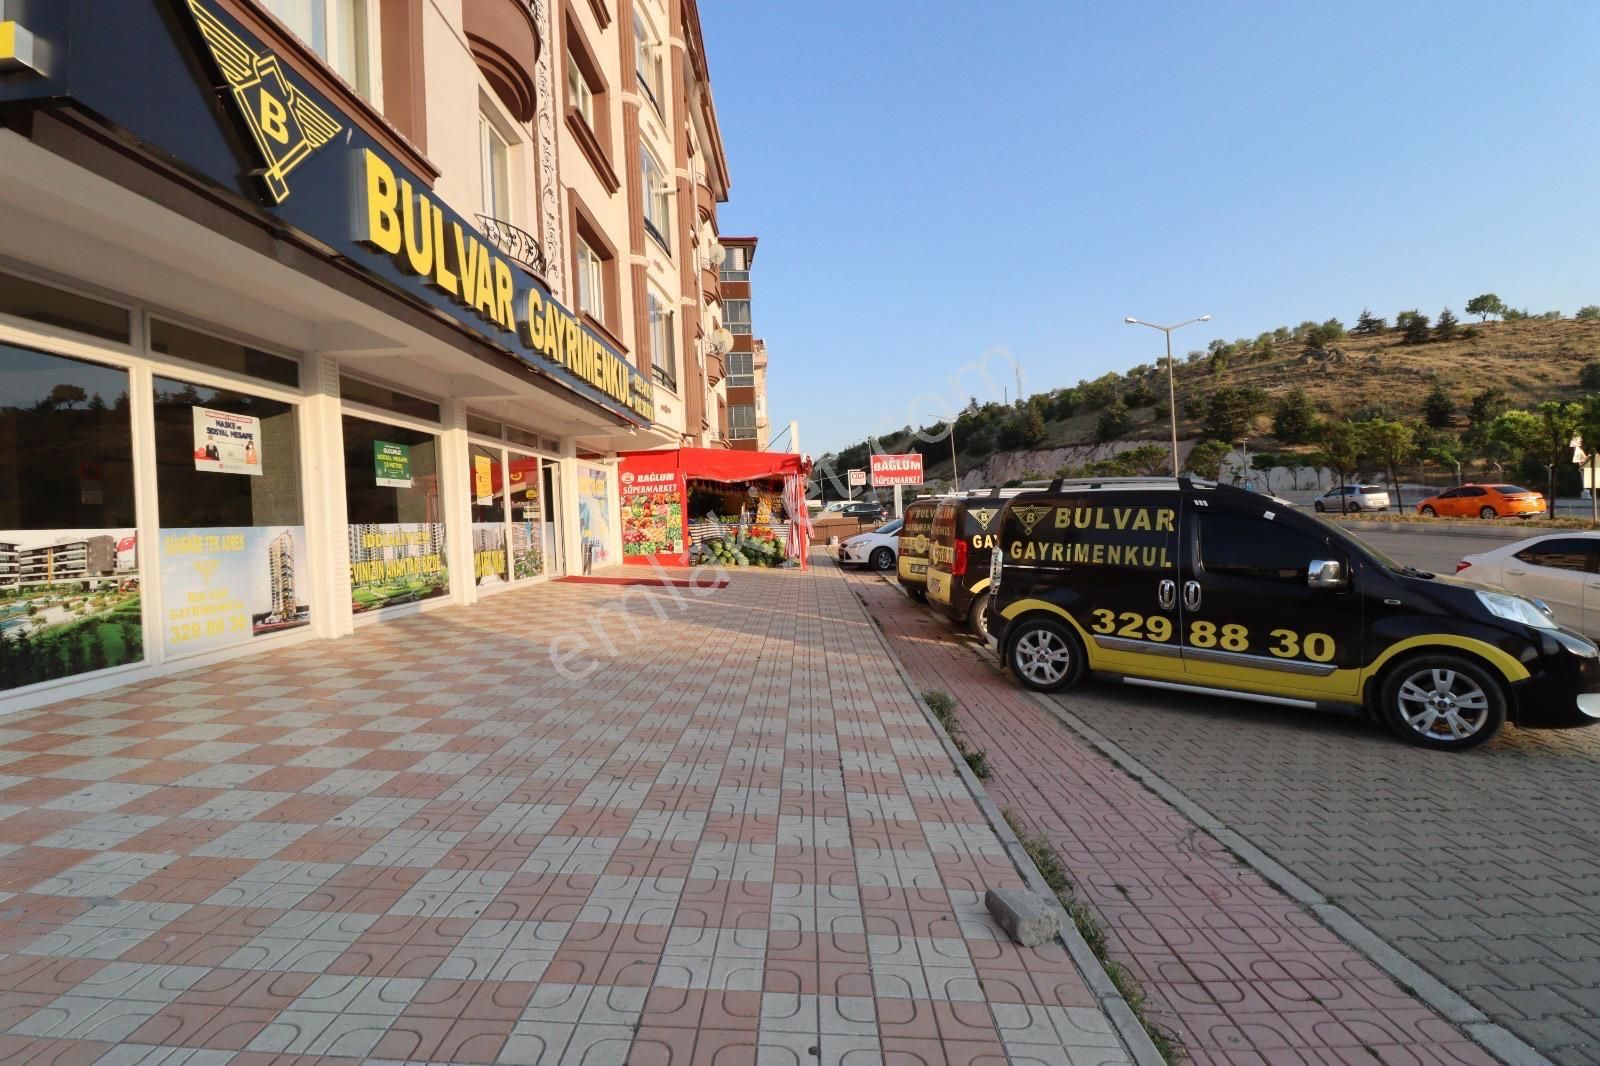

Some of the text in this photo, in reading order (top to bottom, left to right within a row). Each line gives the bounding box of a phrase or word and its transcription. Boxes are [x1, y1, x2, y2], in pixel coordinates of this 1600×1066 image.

[259, 87, 289, 144] B
[365, 147, 517, 333] BULVAR
[206, 427, 254, 441] SOSYAL MESAFE
[873, 457, 921, 472] BAĞLUM
[637, 472, 675, 483] BAĞLUM
[1026, 512, 1036, 524] B
[1054, 507, 1176, 532] BULVAR
[1091, 608, 1337, 662] 329 88 30
